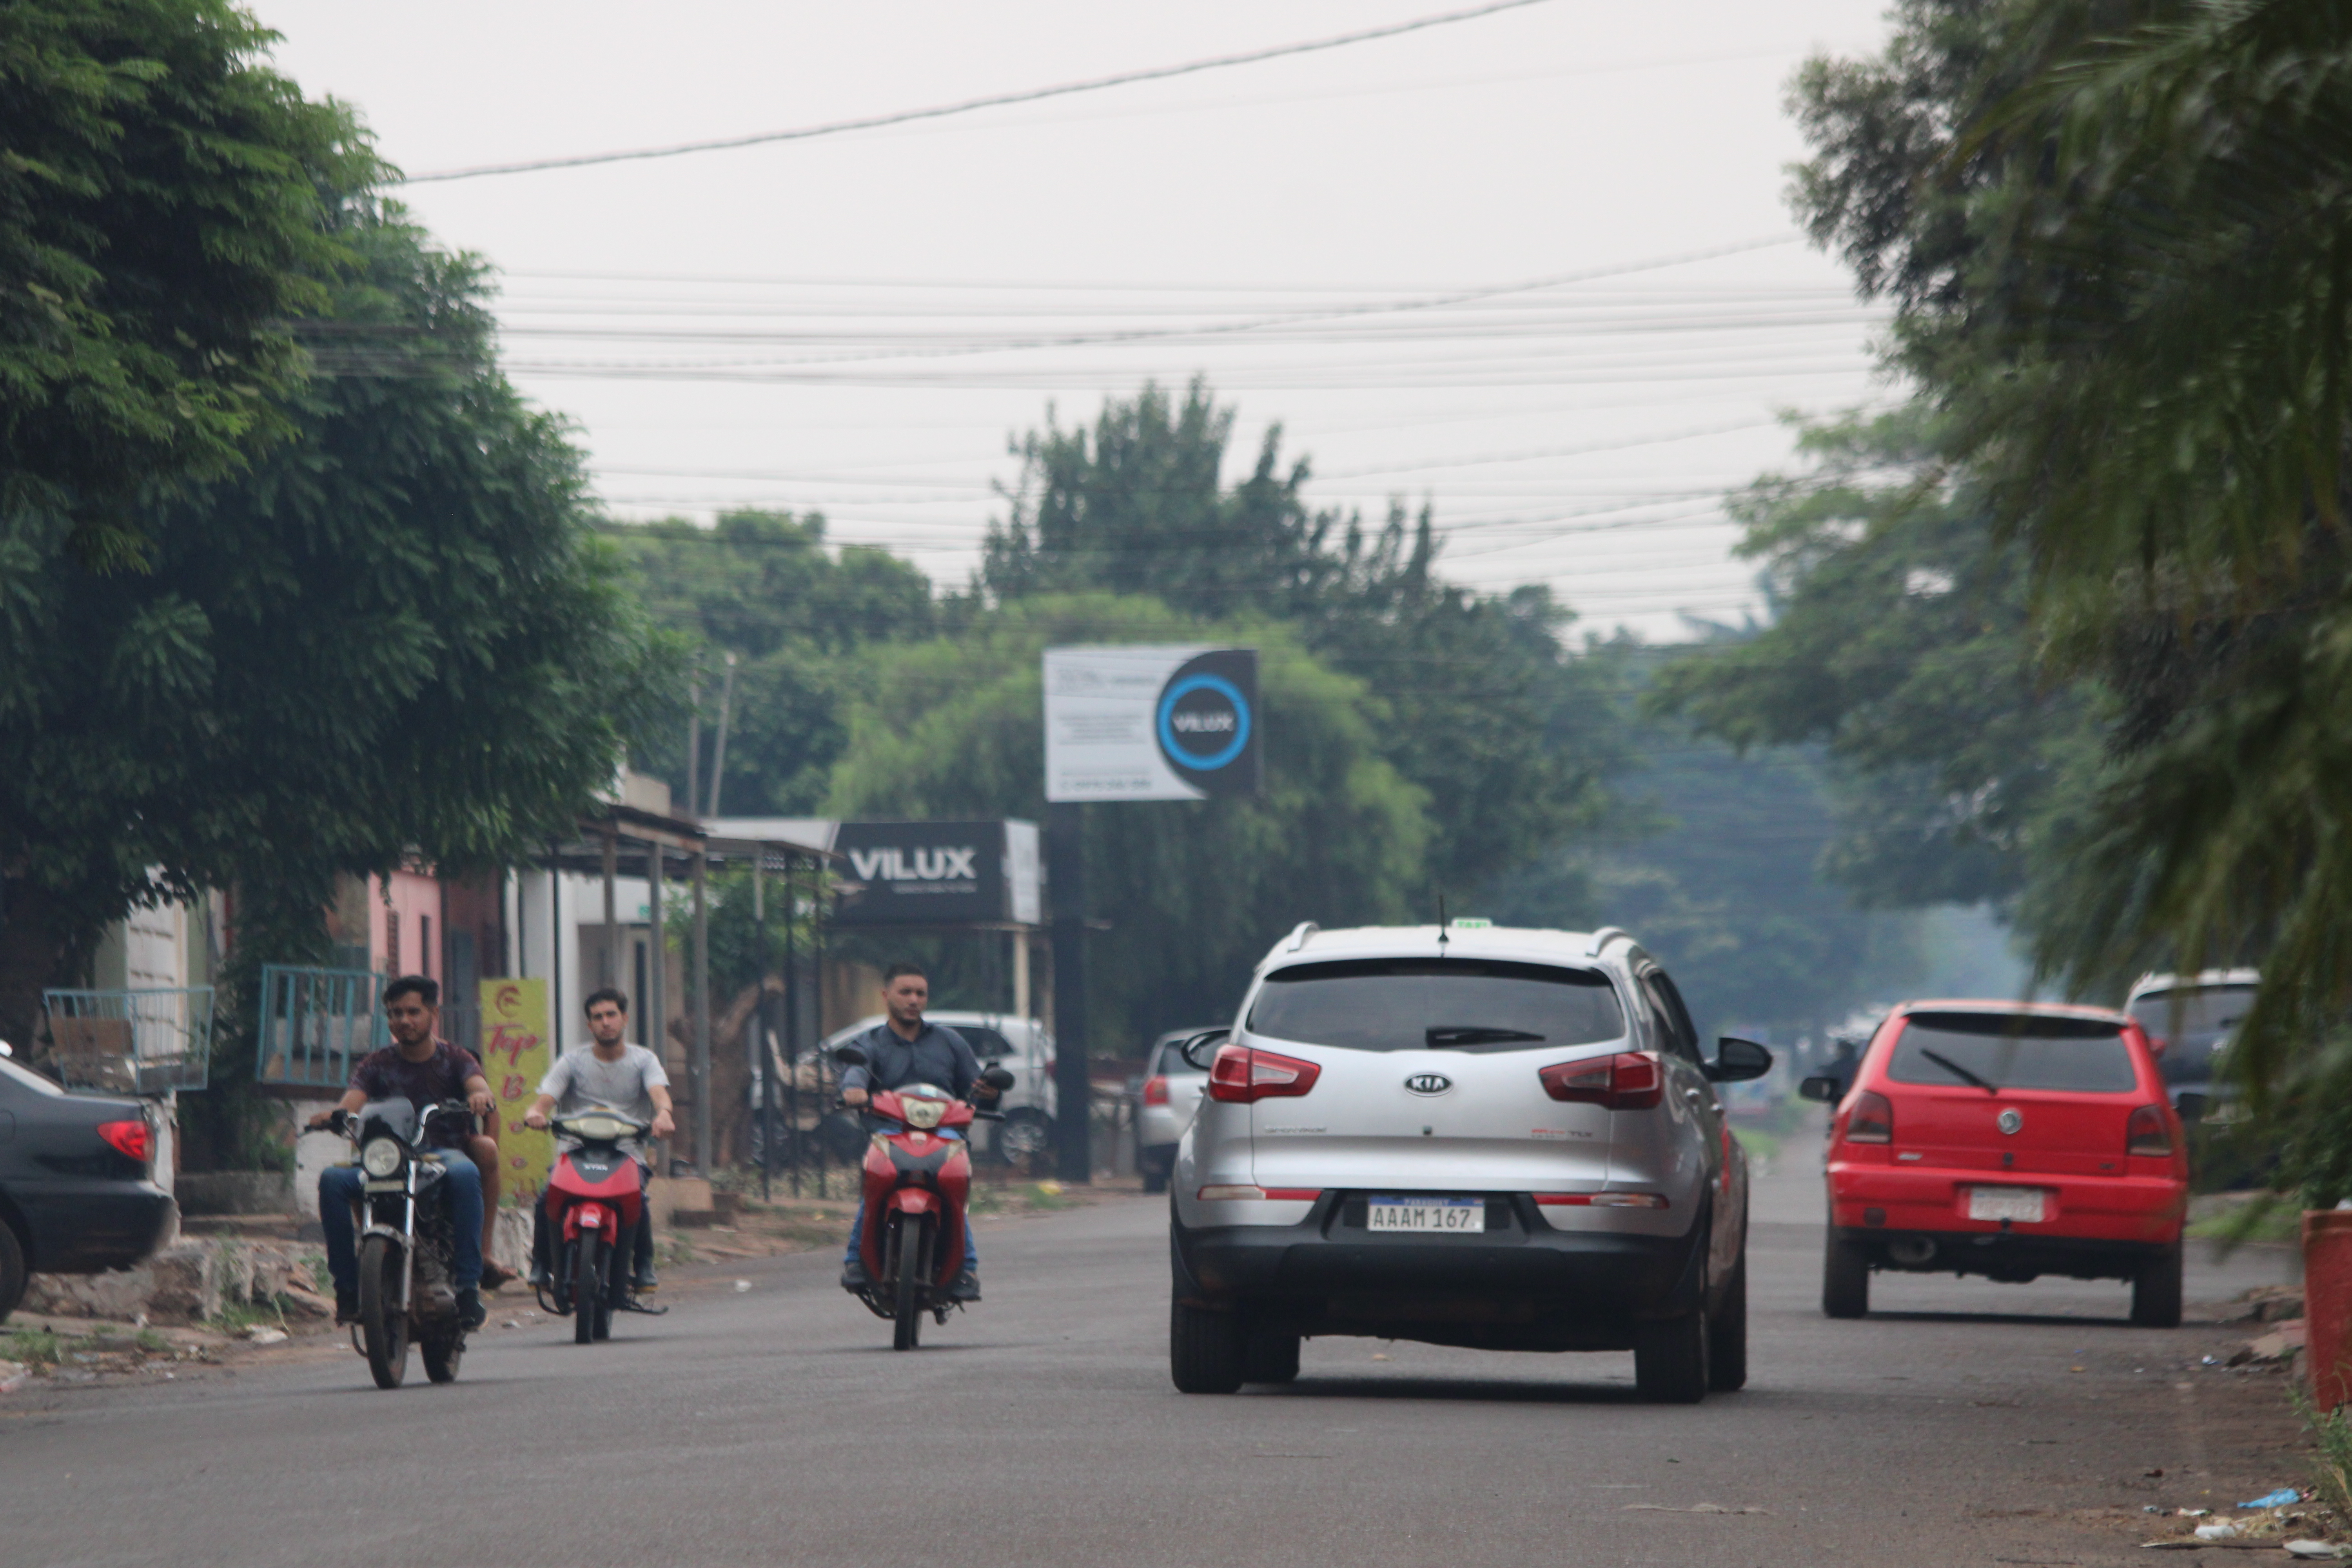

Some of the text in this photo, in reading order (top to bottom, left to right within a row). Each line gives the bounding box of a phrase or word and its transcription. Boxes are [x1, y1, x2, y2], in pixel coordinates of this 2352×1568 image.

[848, 847, 977, 880] VILUX
[1412, 1077, 1445, 1090] KIA
[1433, 1208, 1470, 1229] 167
